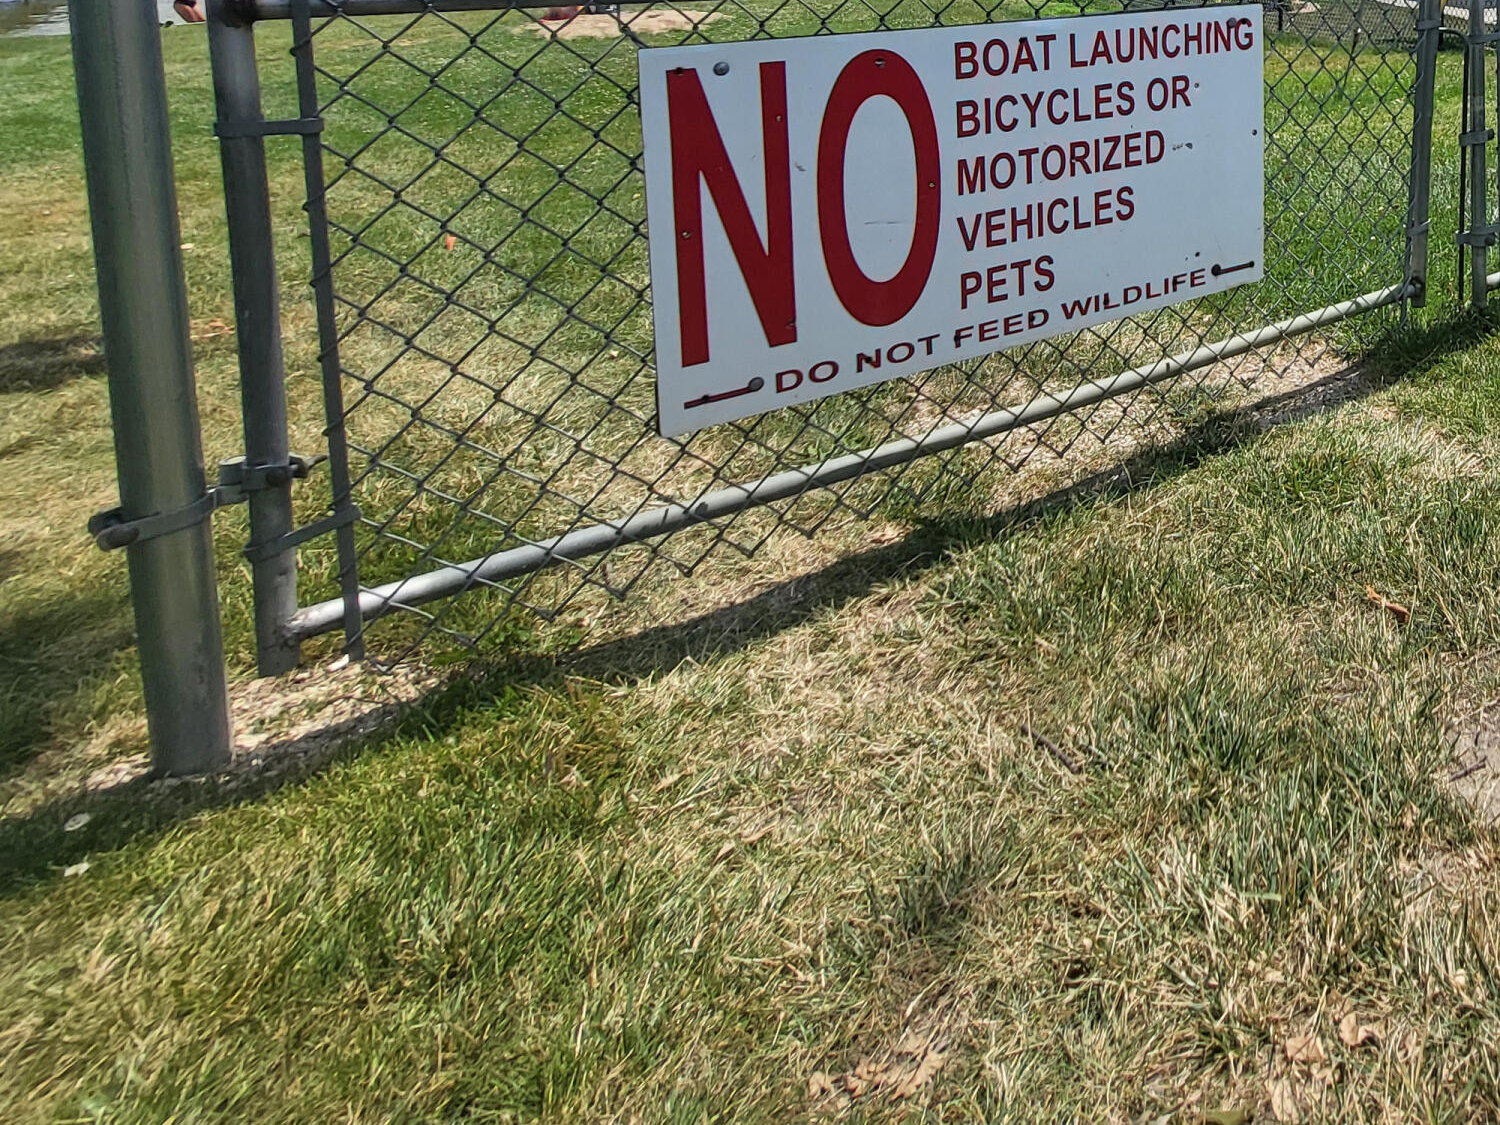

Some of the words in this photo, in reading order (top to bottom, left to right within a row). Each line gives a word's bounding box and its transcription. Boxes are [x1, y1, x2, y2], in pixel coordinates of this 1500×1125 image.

[954, 35, 1057, 80] BOAT
[1070, 18, 1254, 69] LAUNCHING
[956, 76, 1135, 138] BICYCLES
[1147, 75, 1191, 110] OR
[957, 129, 1165, 196] MOTORIZED
[665, 48, 941, 368] NO
[957, 186, 1135, 252] VEHICLES
[960, 256, 1055, 310] PETS
[775, 361, 839, 394] DO
[856, 334, 940, 372] NOT
[955, 308, 1049, 346] FEED
[1061, 267, 1206, 319] WILDLIFE
